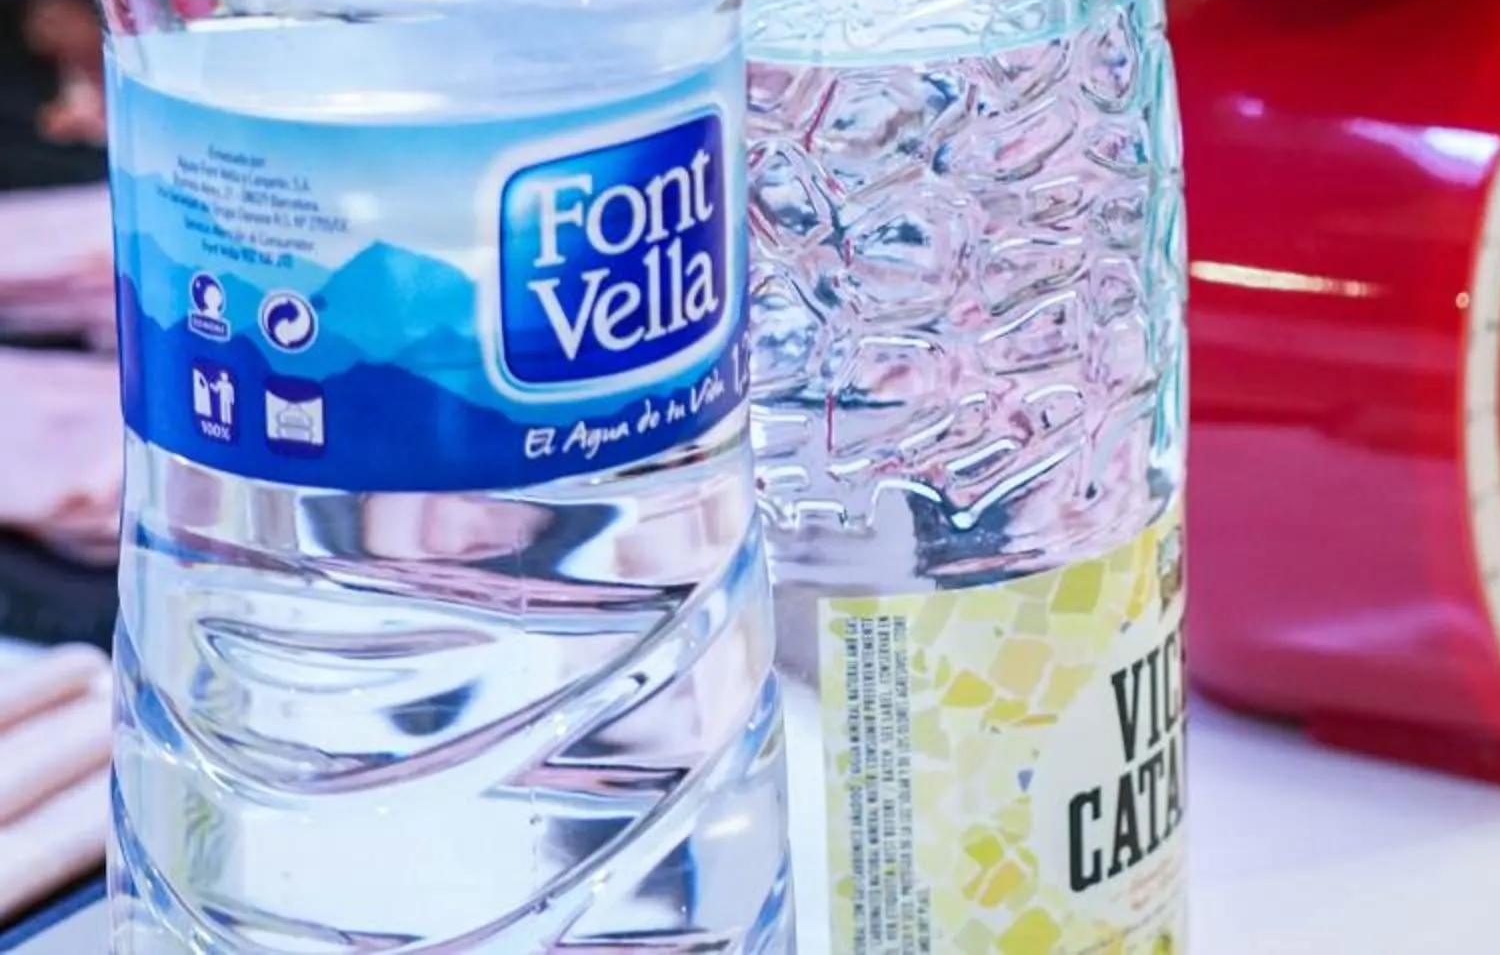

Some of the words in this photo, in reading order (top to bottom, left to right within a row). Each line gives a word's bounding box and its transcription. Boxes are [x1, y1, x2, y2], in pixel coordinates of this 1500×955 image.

[534, 149, 713, 267] Font
[527, 237, 719, 361] Vella
[524, 427, 556, 459] El
[562, 420, 630, 459] Agua
[637, 399, 660, 435] de
